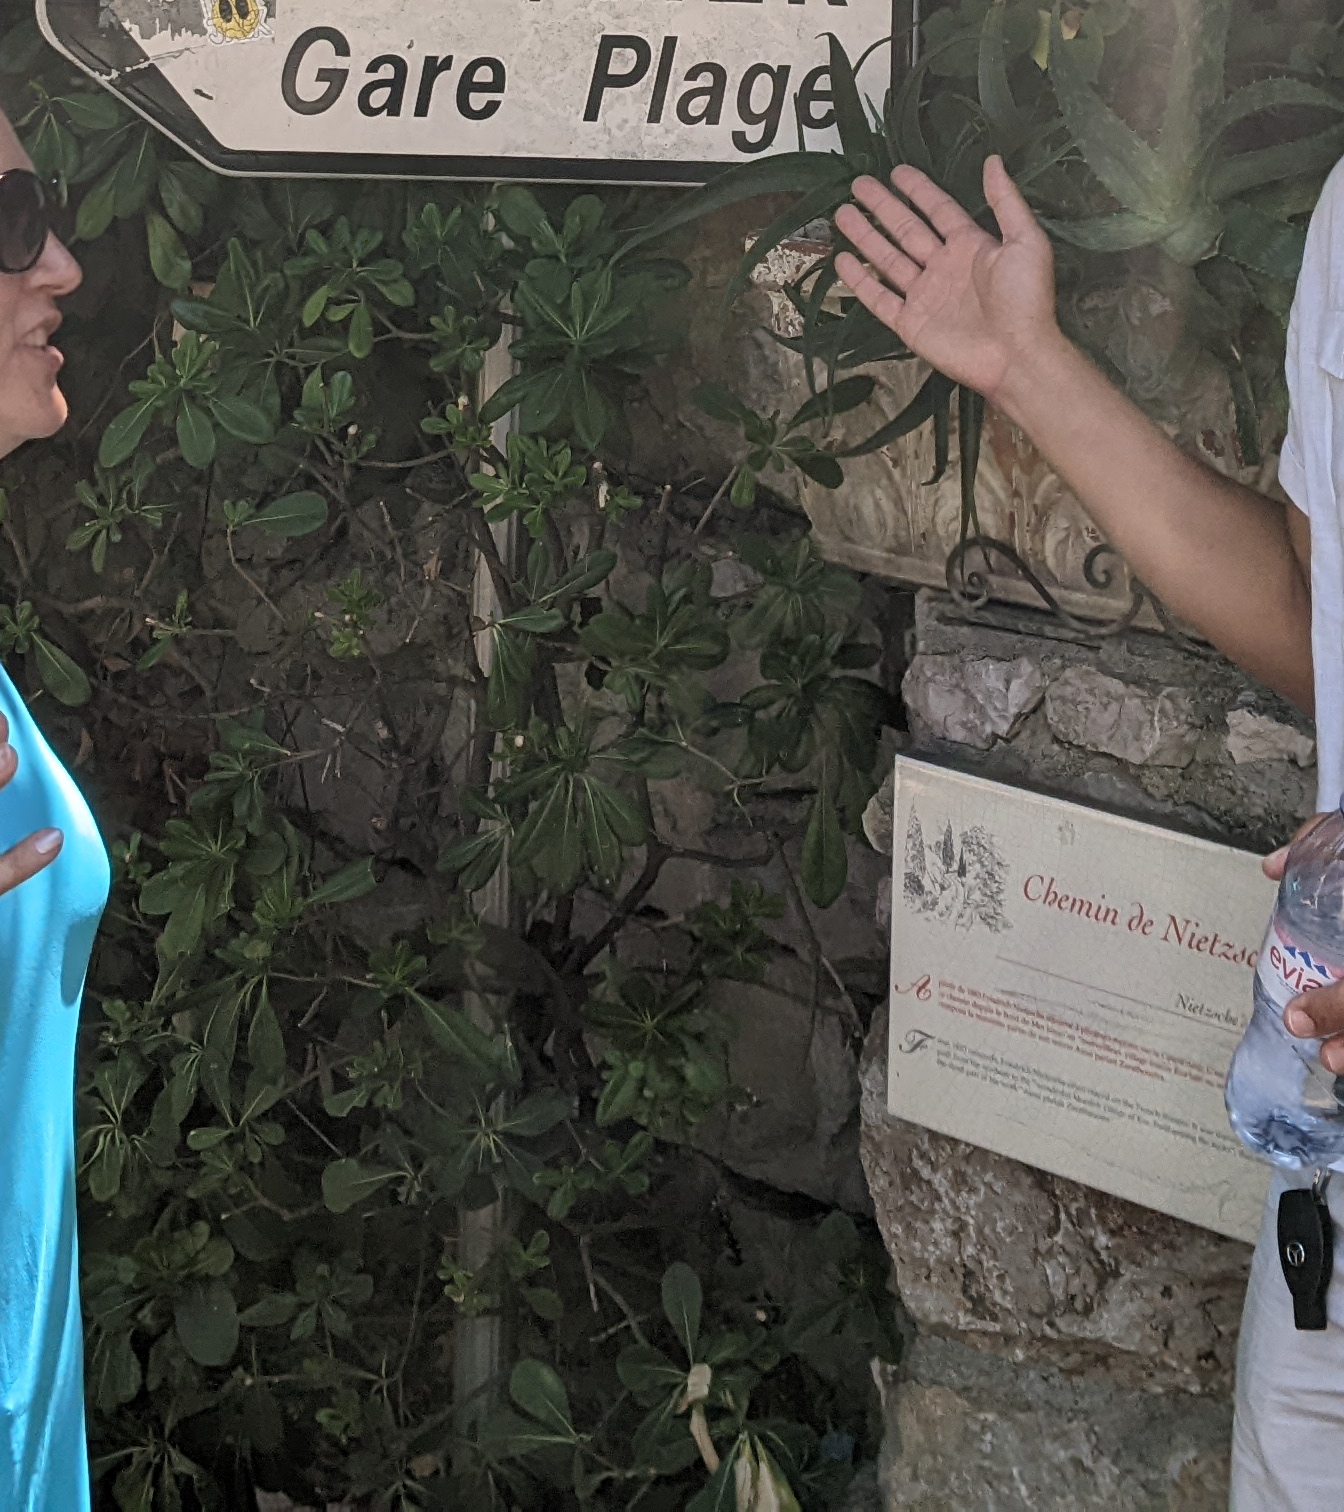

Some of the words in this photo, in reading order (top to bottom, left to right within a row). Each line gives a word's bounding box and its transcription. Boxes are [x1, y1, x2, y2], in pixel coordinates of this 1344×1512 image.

[281, 26, 506, 121] Gare
[583, 35, 838, 153] Plage
[1024, 874, 1119, 926] Chemin
[1128, 902, 1154, 936] de
